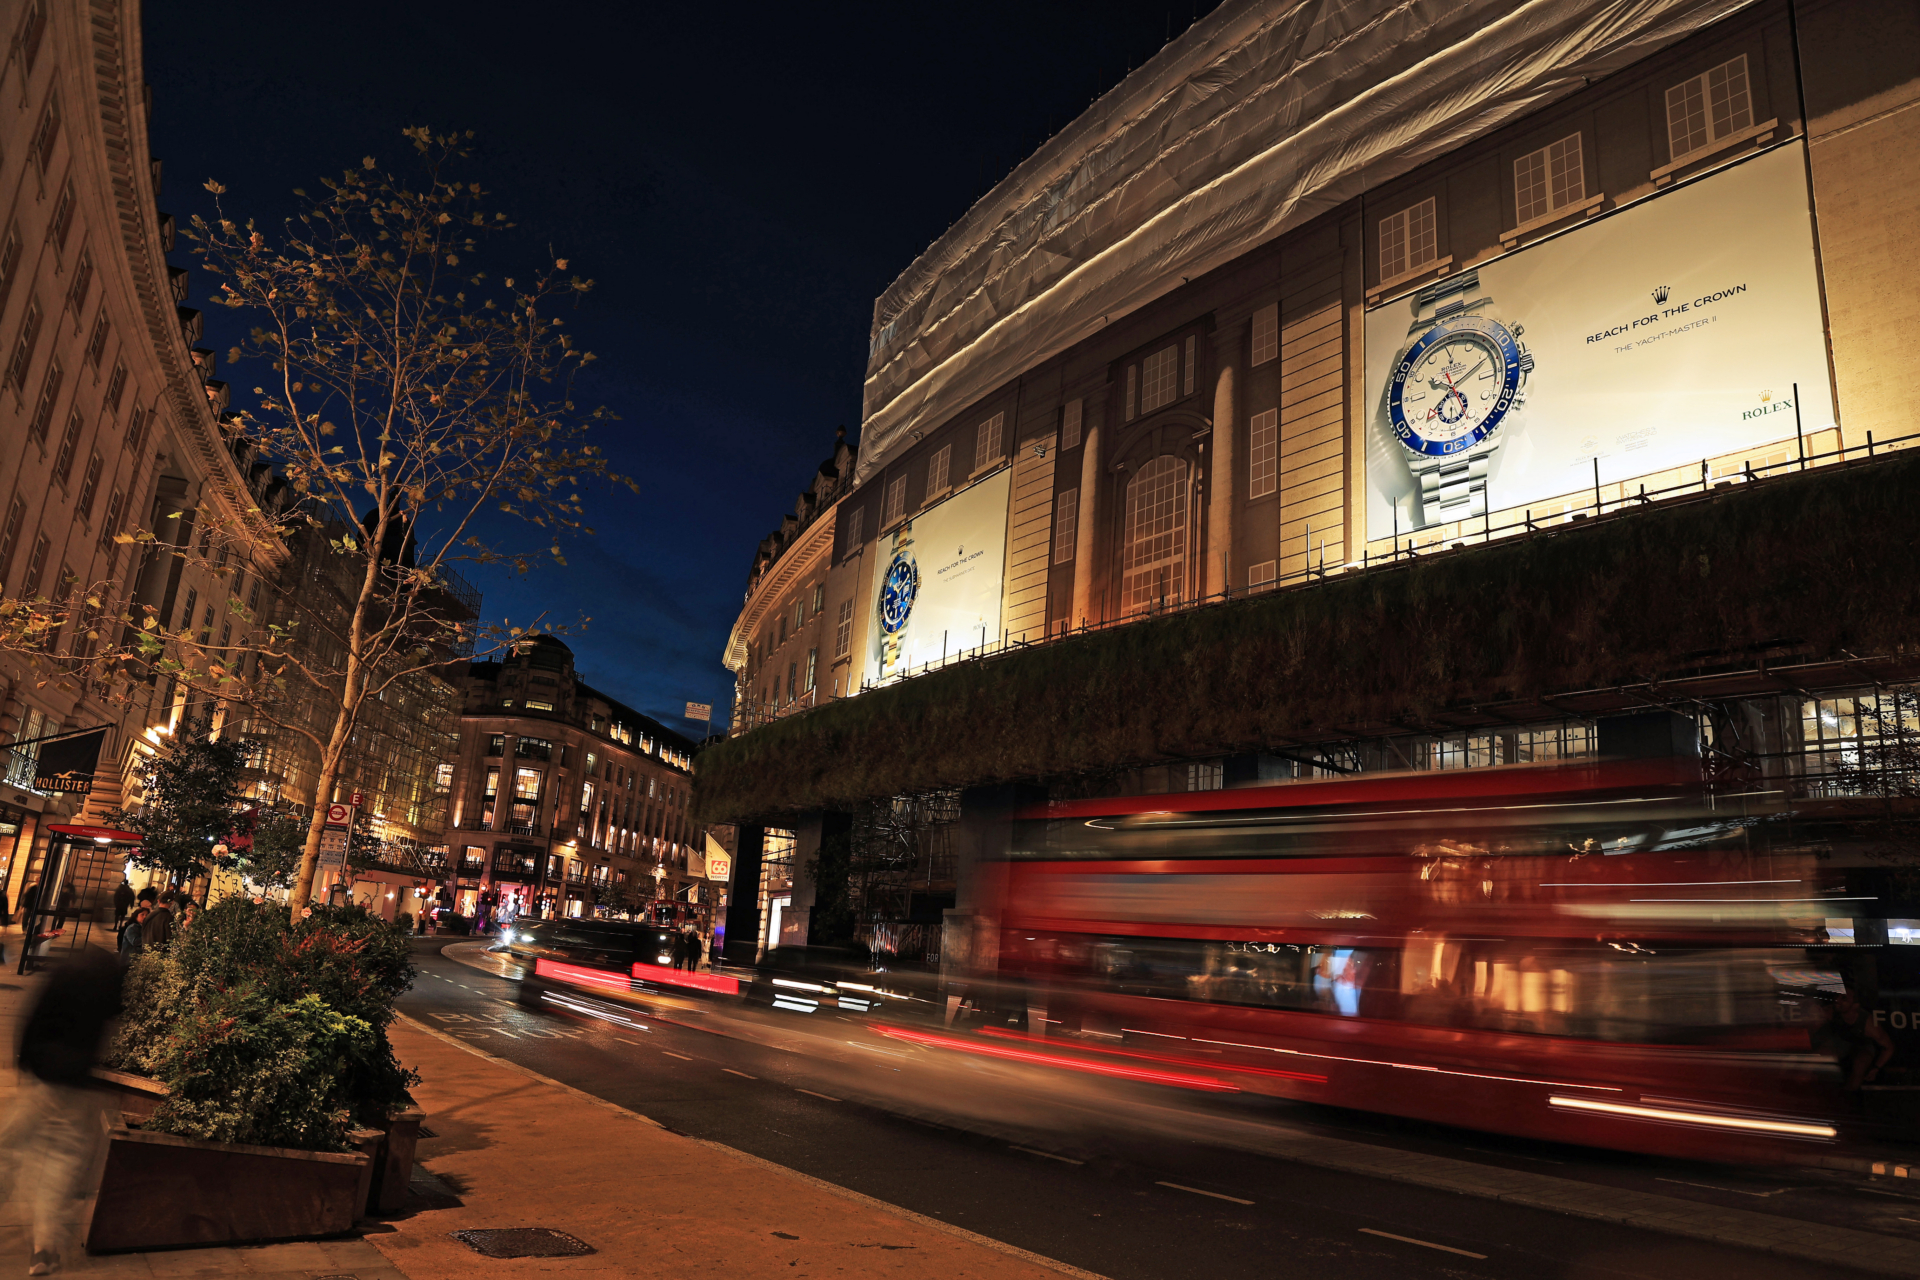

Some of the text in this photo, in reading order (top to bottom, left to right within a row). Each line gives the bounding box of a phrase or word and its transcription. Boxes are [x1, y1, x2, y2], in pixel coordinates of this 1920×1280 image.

[1586, 283, 1747, 344] REACH FOR THE CROWN
[1496, 330, 1511, 346] 10
[1614, 343, 1633, 354] THE
[1635, 318, 1710, 347] YACHT-MASTER
[1396, 361, 1411, 383] 50
[1441, 361, 1462, 371] ROLEX
[1496, 388, 1513, 411] 20
[1742, 399, 1793, 421] ROLEX
[1443, 439, 1465, 453] 30
[937, 566, 951, 575] REACH
[959, 556, 968, 565] THE
[968, 550, 984, 561] CROWN
[35, 777, 91, 792] HOLLISTER
[353, 794, 360, 804] E
[712, 861, 727, 874] 66
